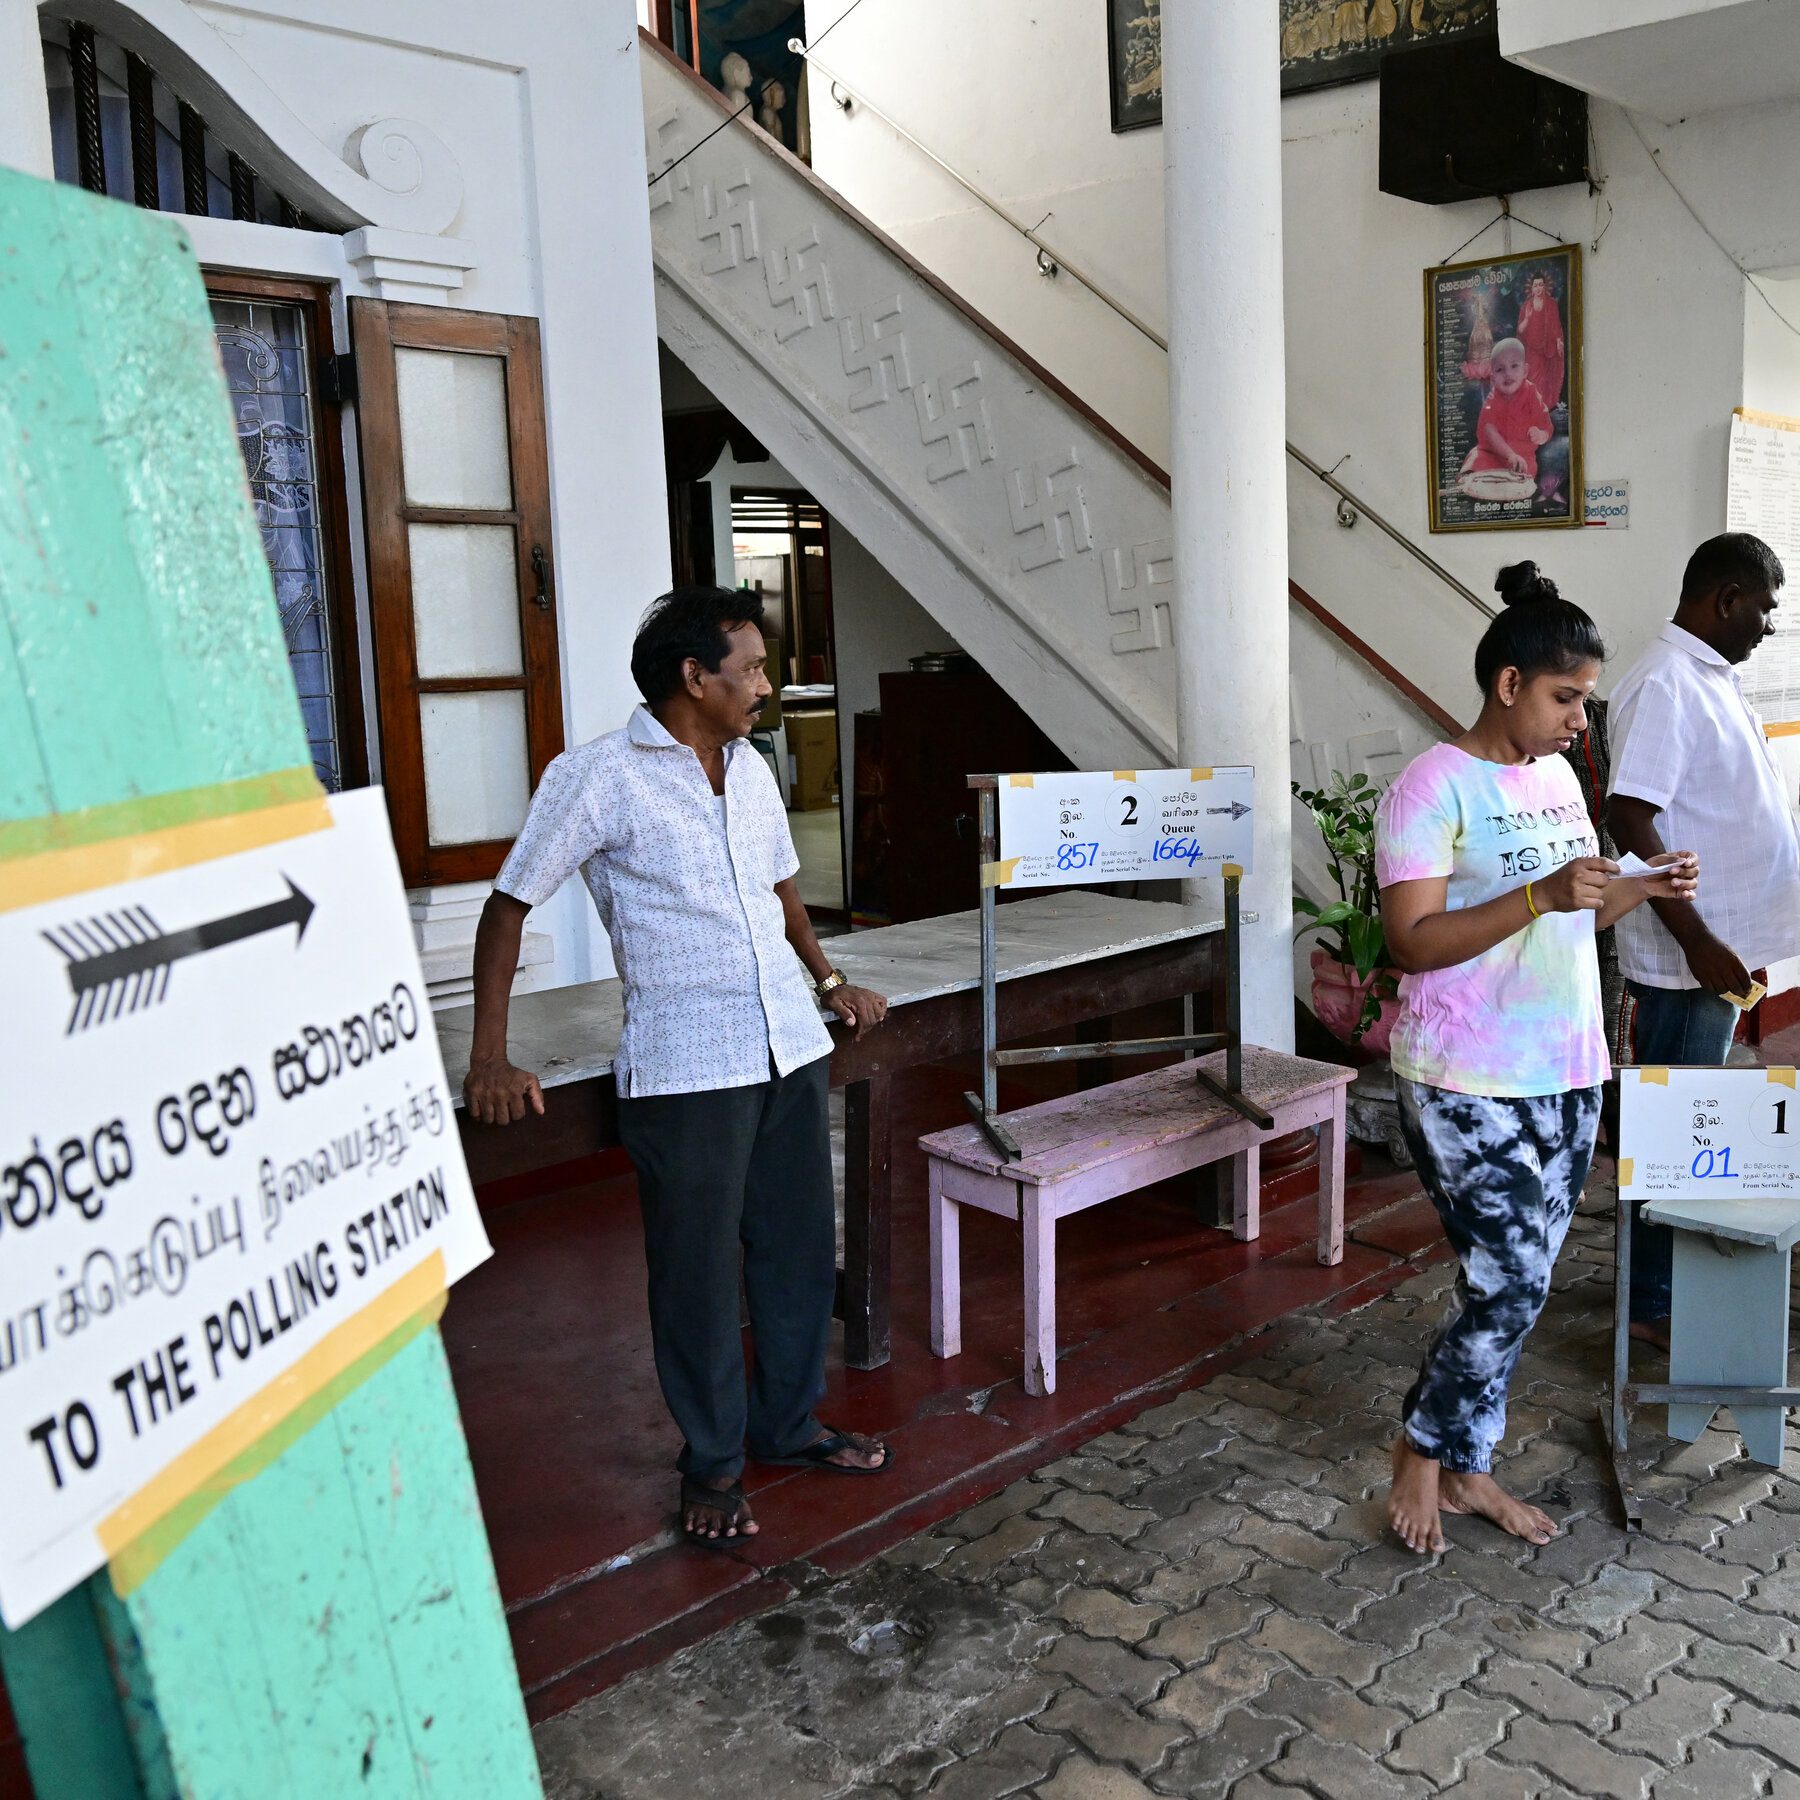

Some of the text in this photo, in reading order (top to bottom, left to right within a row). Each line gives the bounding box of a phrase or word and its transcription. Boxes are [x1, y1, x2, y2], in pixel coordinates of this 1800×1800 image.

[1059, 798, 1081, 808] අංක
[1162, 791, 1198, 804] පෝලිම
[1120, 795, 1139, 826] 2
[1162, 806, 1200, 818] வரிசை
[1060, 829, 1078, 840] No.
[1161, 824, 1196, 836] Queue
[1057, 842, 1099, 871] 857
[1153, 837, 1204, 868] 1664
[1498, 847, 1541, 878] IS
[1547, 836, 1599, 866] LIK
[1693, 1099, 1719, 1110] අංක
[1692, 1113, 1724, 1129] இல.
[1771, 1099, 1790, 1135] 1
[1692, 1135, 1714, 1147] No.
[0, 1119, 133, 1237] න්දය
[156, 1066, 257, 1157] දෙන
[1691, 1146, 1739, 1178] 01
[1781, 1182, 1793, 1190] No.
[29, 1167, 451, 1490] TO THE POLLING STATION
